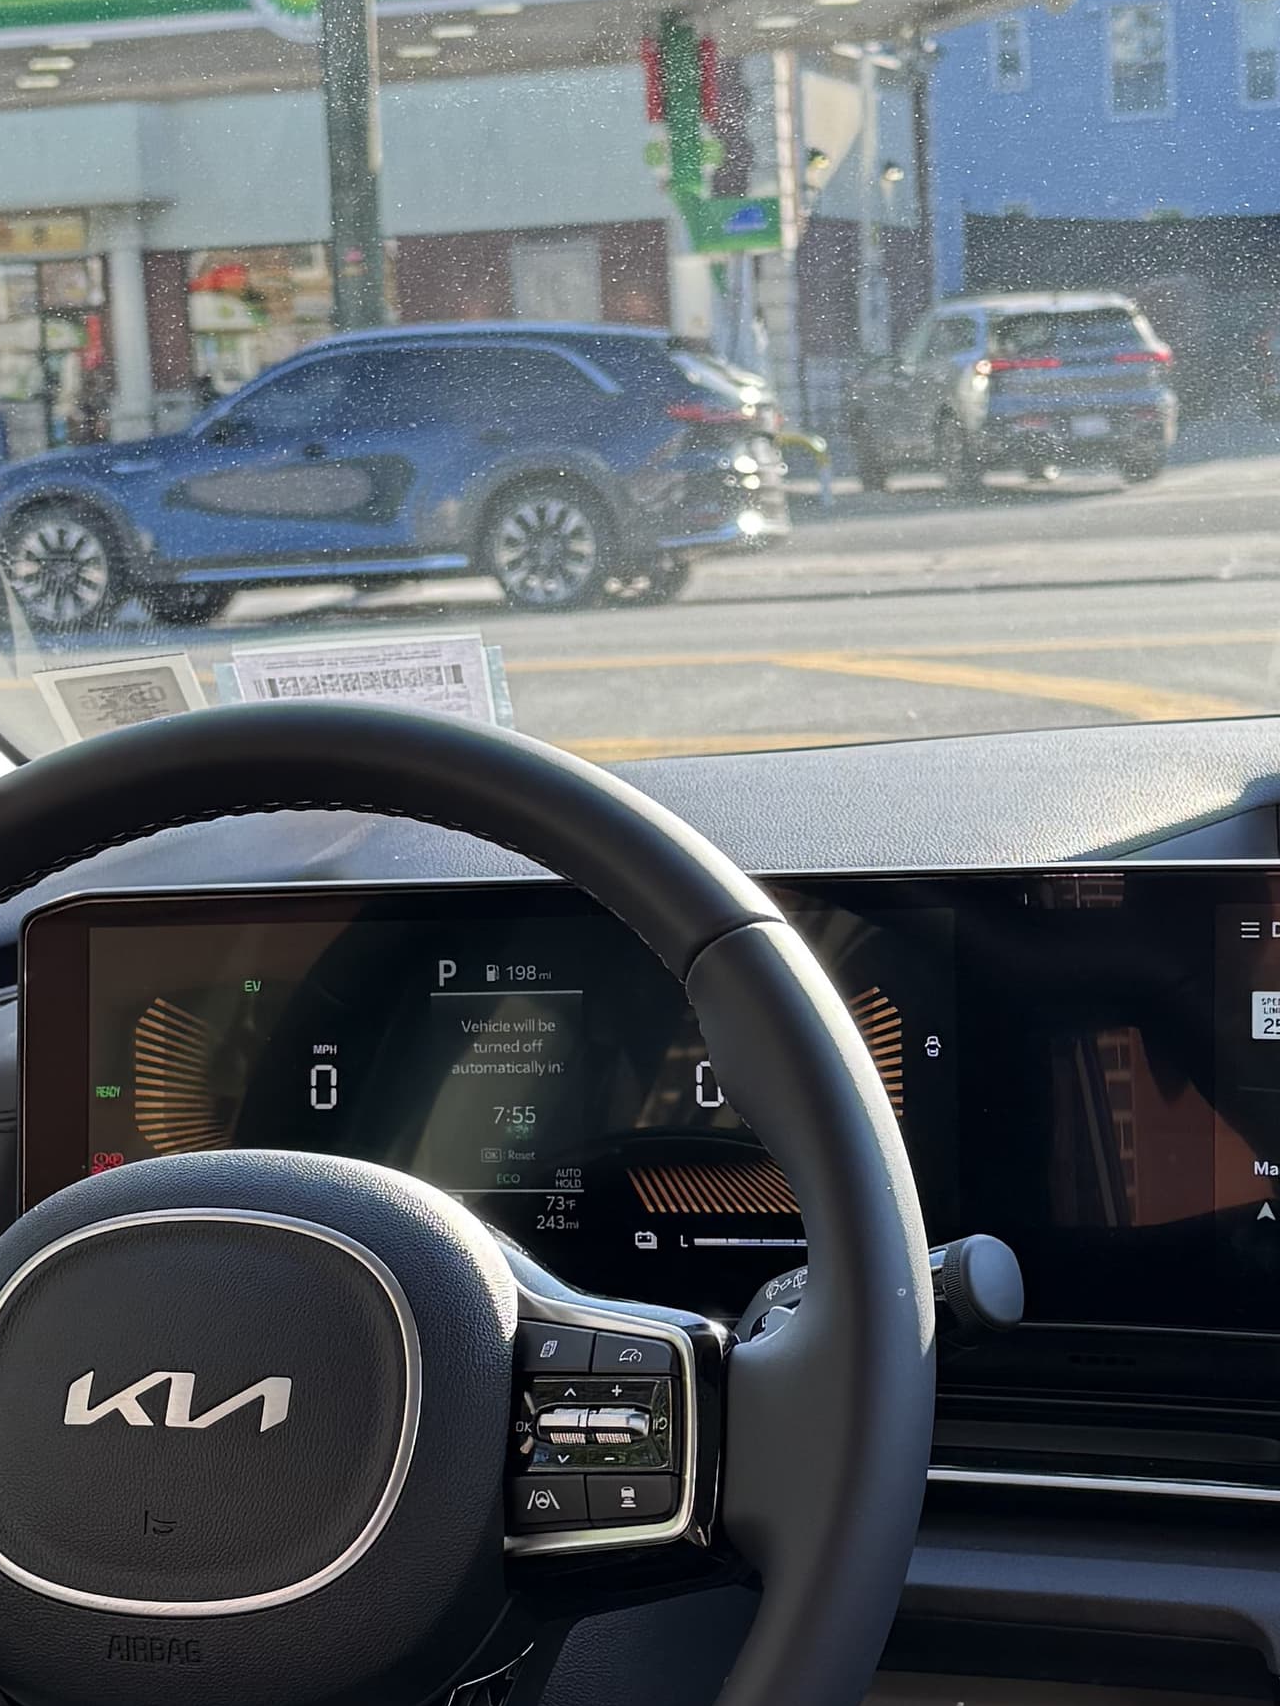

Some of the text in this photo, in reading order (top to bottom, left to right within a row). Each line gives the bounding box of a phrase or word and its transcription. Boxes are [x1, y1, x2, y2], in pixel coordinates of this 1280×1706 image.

[438, 959, 457, 987] P
[244, 979, 262, 992] EV
[460, 1018, 557, 1033] Vehicle will be
[312, 1044, 338, 1056] MPH
[473, 1039, 545, 1054] turned off
[451, 1060, 546, 1077] automatically
[310, 1064, 338, 1110] 0
[492, 1105, 537, 1125] 7:55
[507, 1149, 537, 1161] Reset
[496, 1173, 521, 1185] ECO
[555, 1167, 582, 1178] AUTO
[555, 1178, 582, 1189] HOLD
[679, 1233, 689, 1248] L
[515, 1420, 533, 1434] OK
[106, 1634, 202, 1665] AIRBAG
